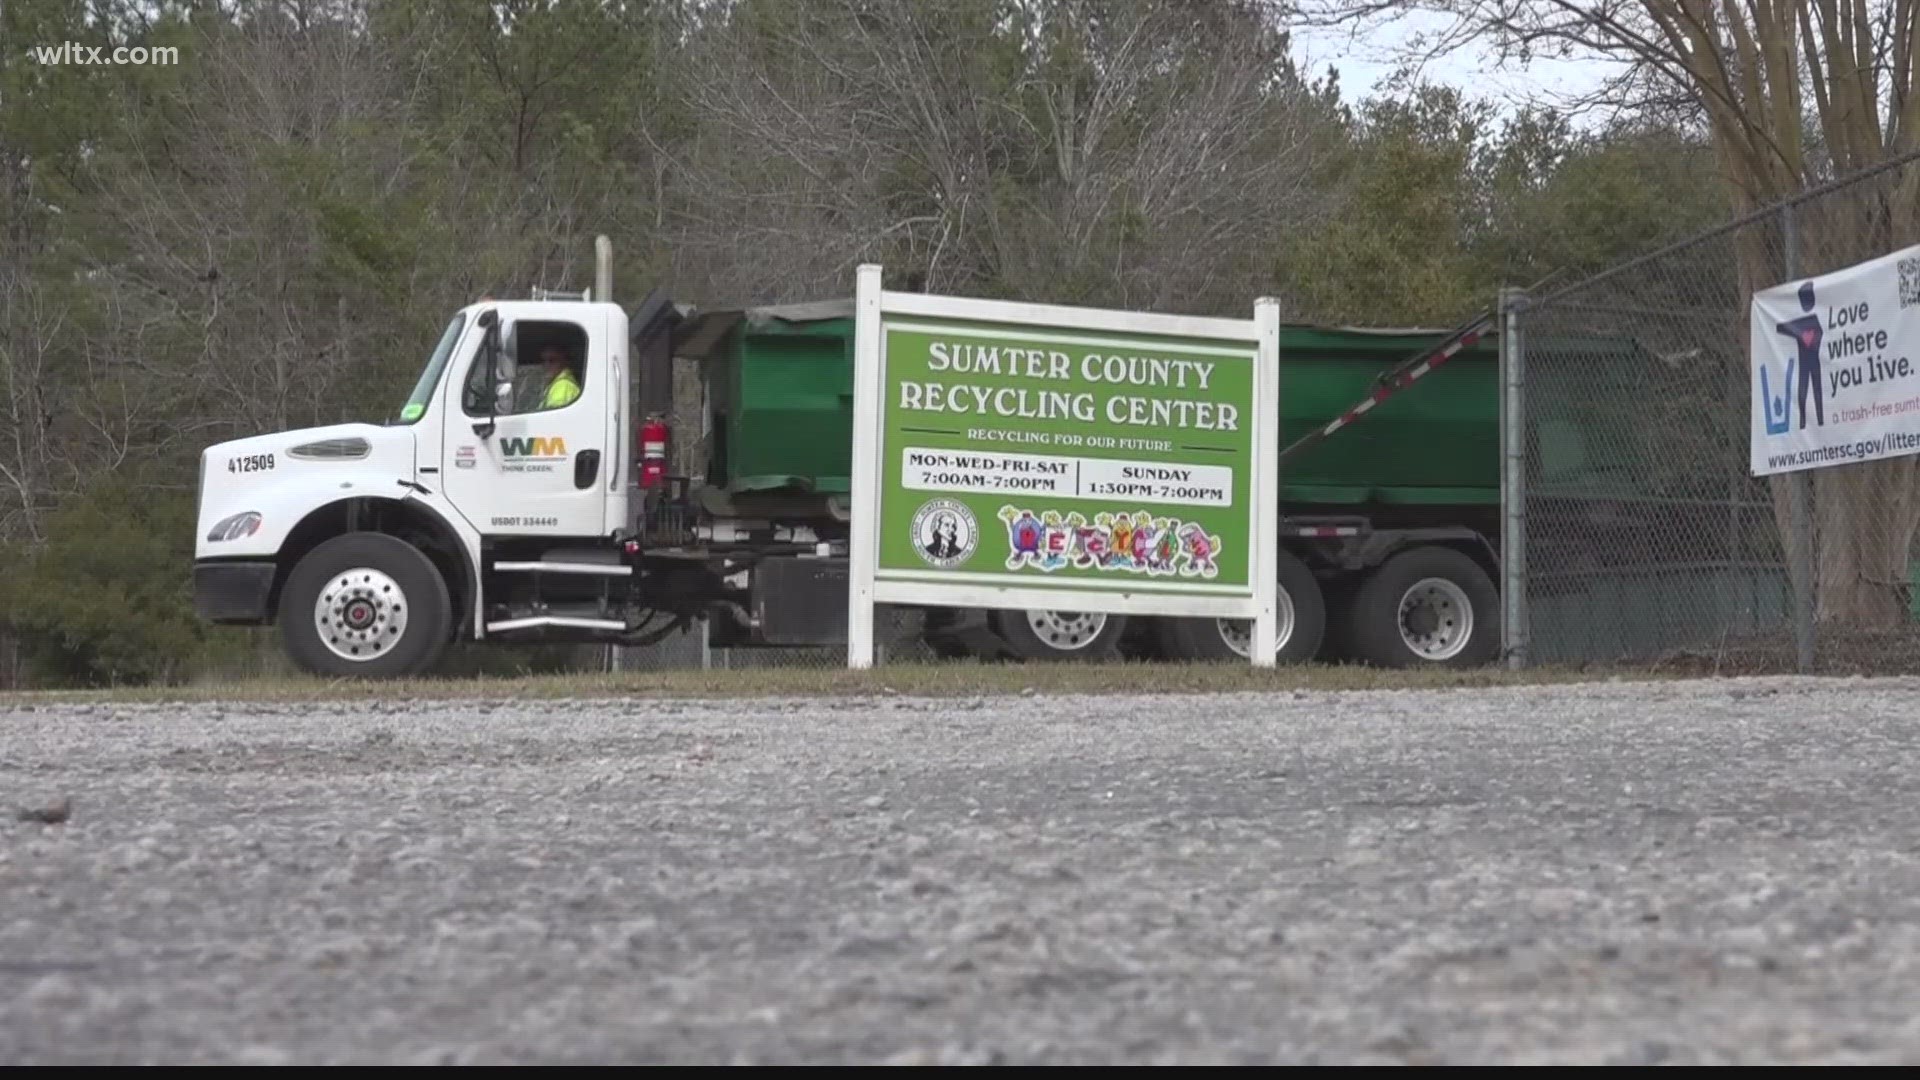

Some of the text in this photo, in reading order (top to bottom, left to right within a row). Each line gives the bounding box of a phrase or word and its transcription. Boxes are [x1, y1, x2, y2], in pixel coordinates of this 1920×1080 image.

[1828, 301, 1869, 330] Love
[1827, 329, 1888, 360] where
[927, 341, 1215, 390] SUMTER COUNTY
[1829, 355, 1915, 398] you live.
[899, 381, 1239, 431] RECYCLING CENTER
[1832, 413, 1839, 424] a
[1841, 401, 1892, 422] trash-free
[500, 437, 567, 456] WM
[967, 428, 1173, 452] RECYCLING FOR OUR FUTURE
[228, 453, 275, 474] 412509
[909, 453, 1069, 475] MON-WED-FRI-SAT
[1122, 466, 1192, 483] SUNDAY
[921, 471, 1056, 491] 7:00AM-7:00PM
[1088, 481, 1224, 501] 1:30PM-7:00PM
[491, 516, 520, 526] USDOT
